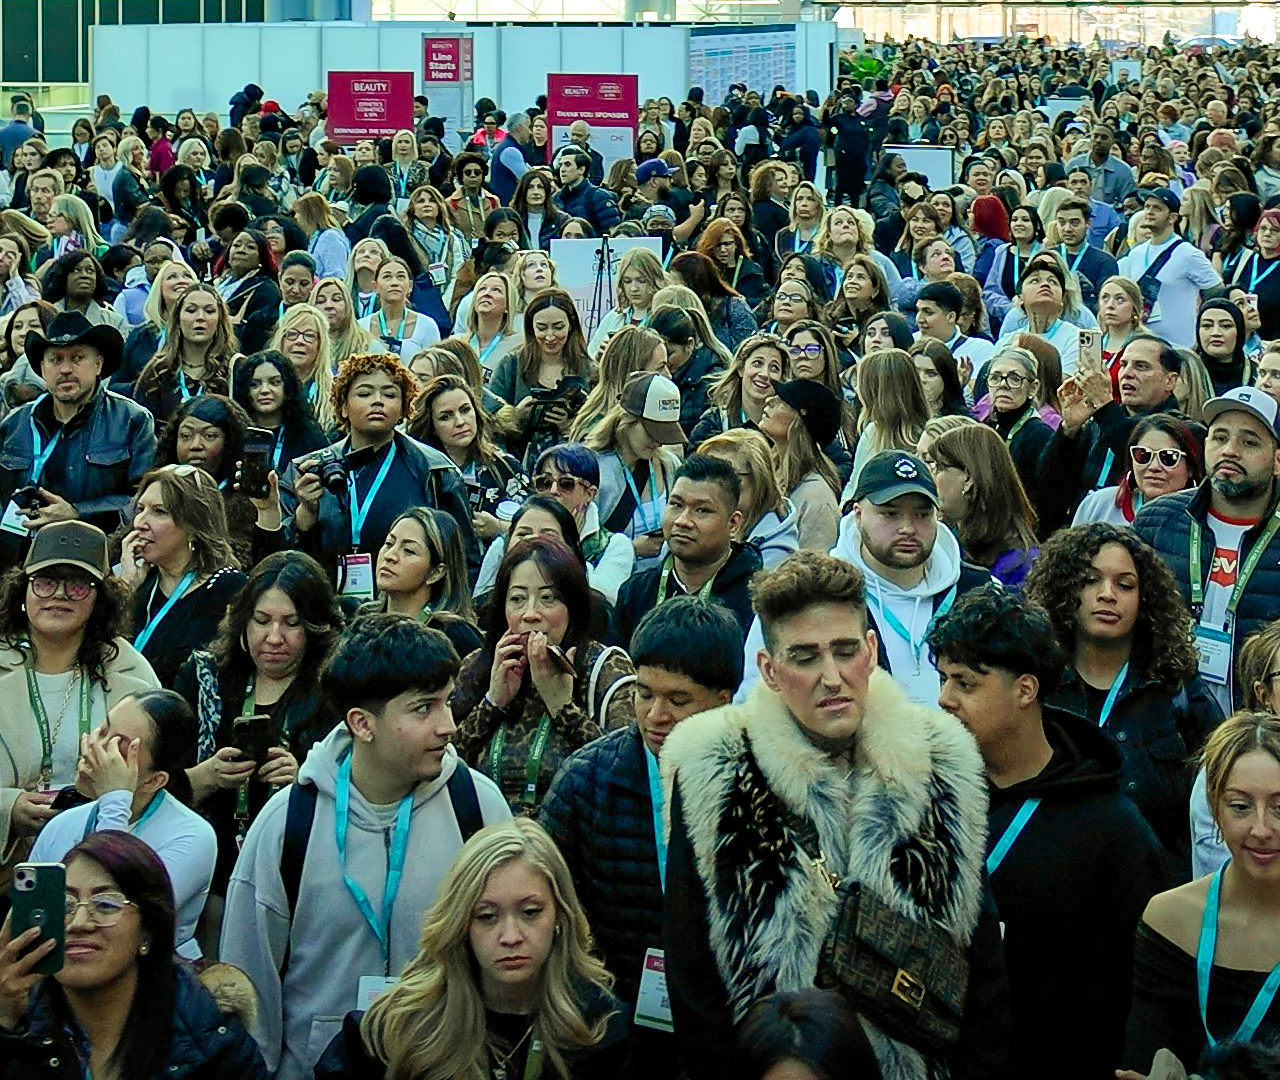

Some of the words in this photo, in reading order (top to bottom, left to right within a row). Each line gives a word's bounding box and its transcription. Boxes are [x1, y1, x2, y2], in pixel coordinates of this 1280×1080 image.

[432, 52, 453, 61] Line
[428, 62, 456, 70] Starts
[431, 71, 453, 79] Here
[354, 83, 388, 92] BEAUTY
